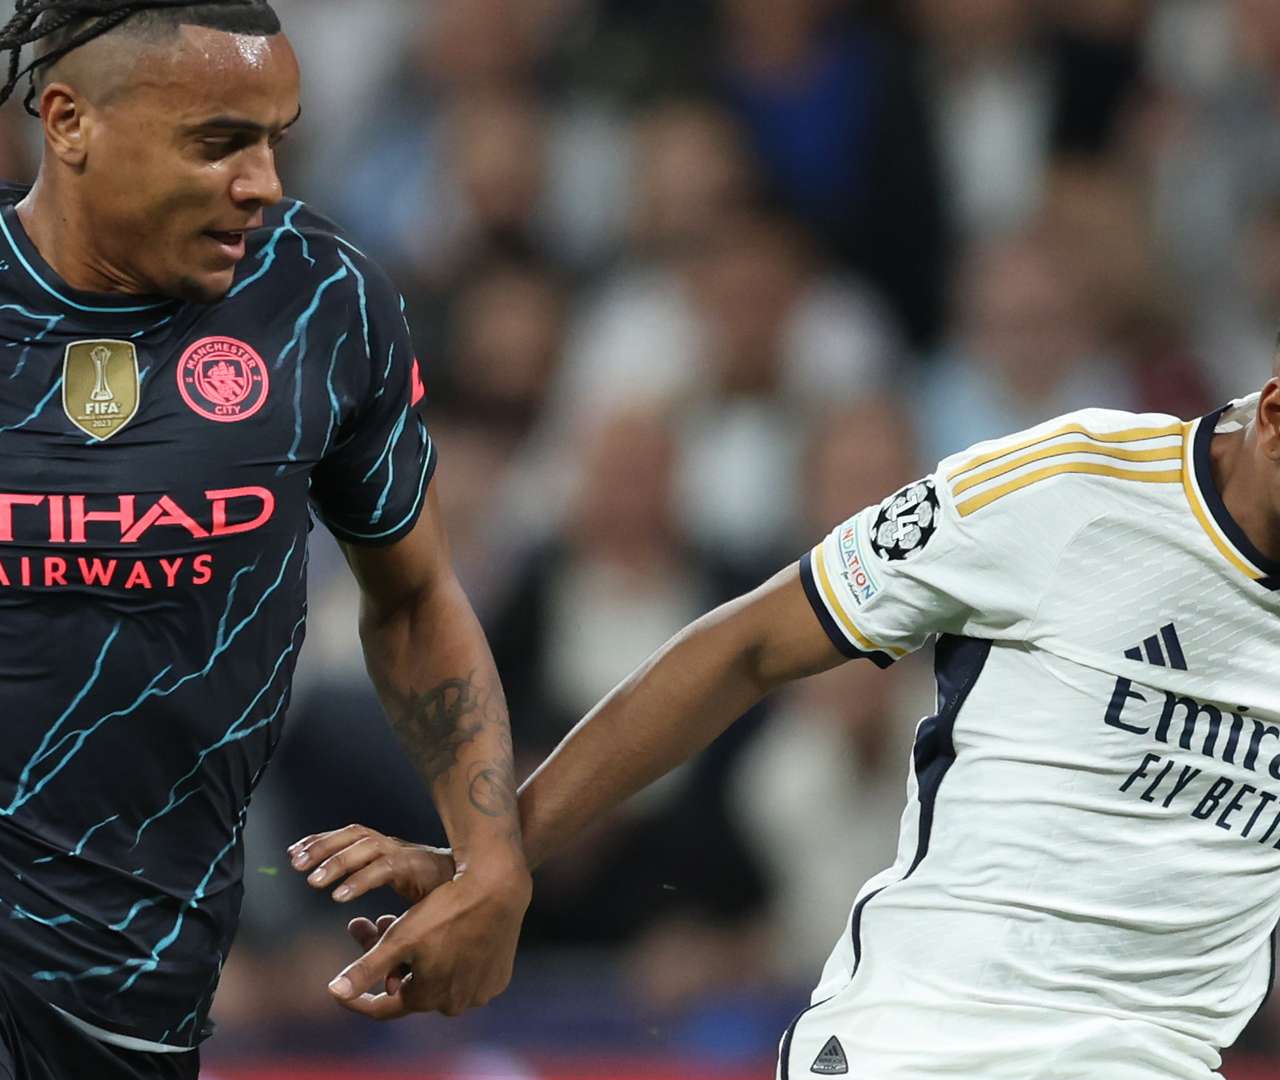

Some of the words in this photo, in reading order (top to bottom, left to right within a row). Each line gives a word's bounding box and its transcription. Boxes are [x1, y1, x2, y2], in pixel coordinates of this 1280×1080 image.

[85, 402, 120, 414] FIFA
[214, 405, 241, 415] CITY
[1118, 752, 1203, 809] FLY
